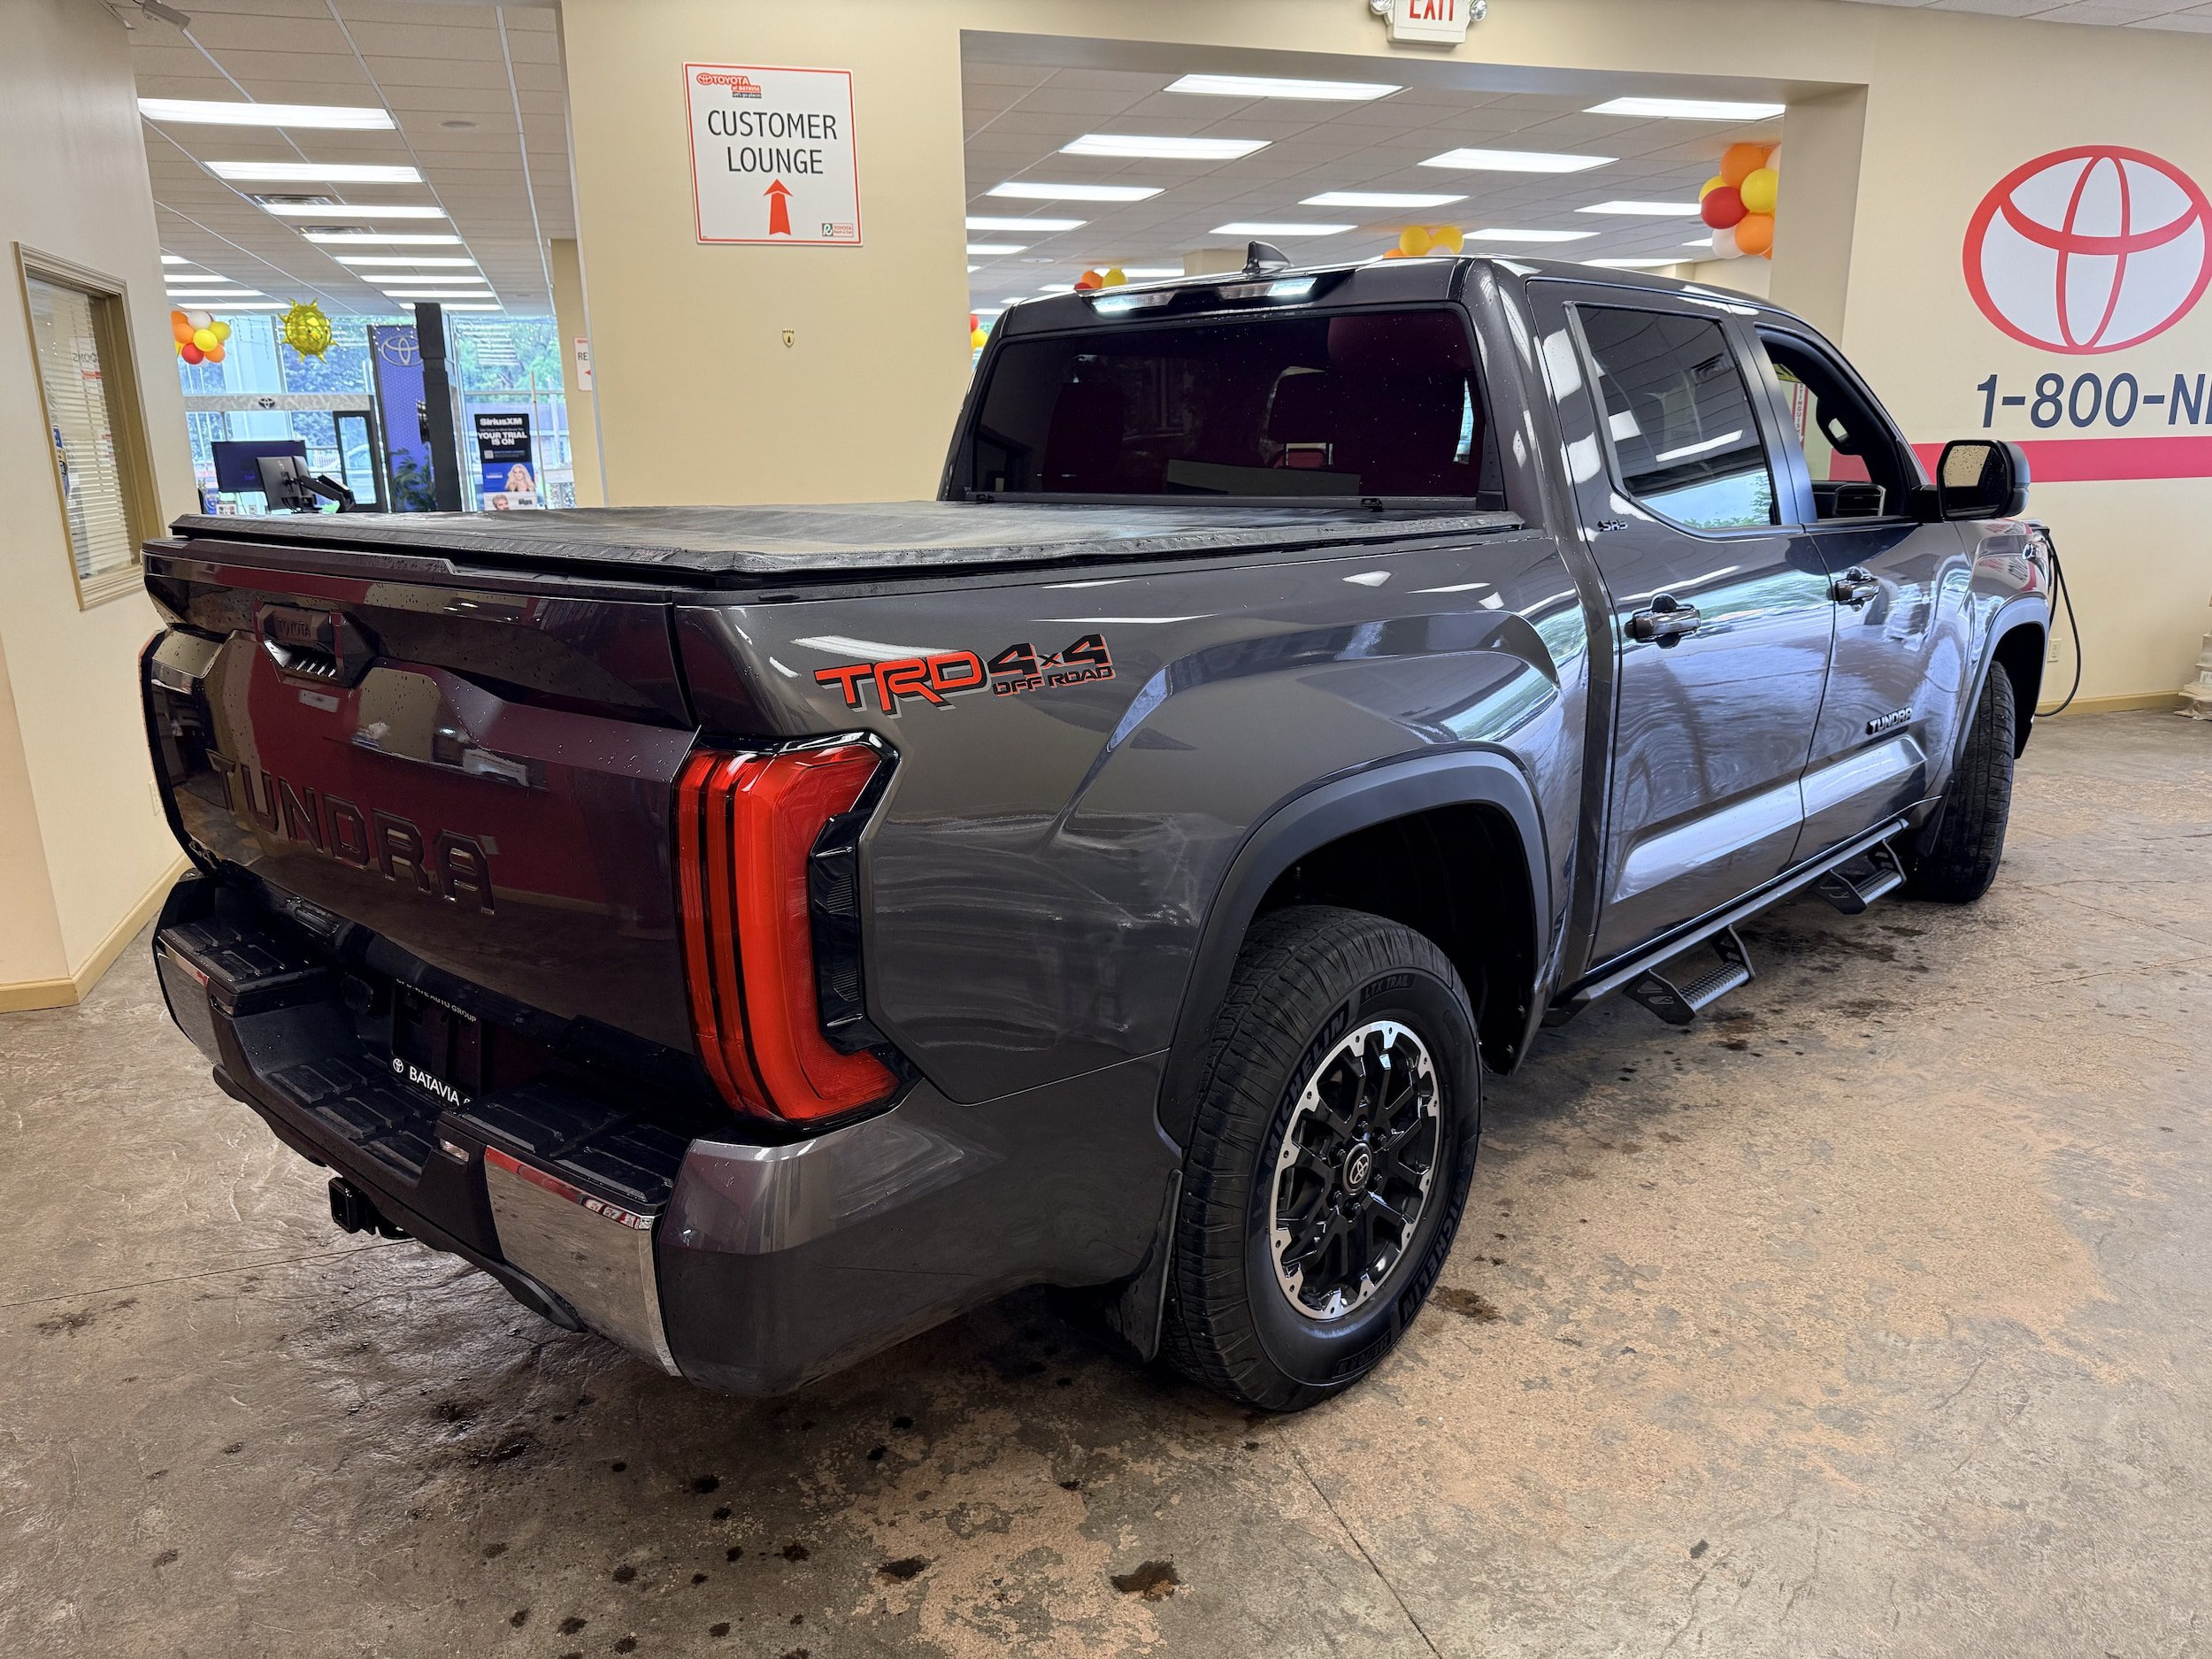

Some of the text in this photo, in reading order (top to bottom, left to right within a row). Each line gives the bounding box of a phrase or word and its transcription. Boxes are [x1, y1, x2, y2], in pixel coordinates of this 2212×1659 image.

[711, 75, 749, 86] TOYOTA
[708, 110, 838, 140] CUSTOMER
[726, 146, 824, 174] LOUNGE
[1977, 372, 2212, 429] 1-800-N
[814, 634, 1112, 718] TRD 4x4
[993, 666, 1116, 697] OFF ROAD
[1866, 707, 1913, 734] TUNDRA
[205, 749, 495, 915] TUNDRA
[1364, 979, 1384, 999] LTX
[451, 1004, 477, 1023] GROUP
[409, 1065, 460, 1107] BATAVIA
[1263, 1007, 1347, 1171] MICHELIN
